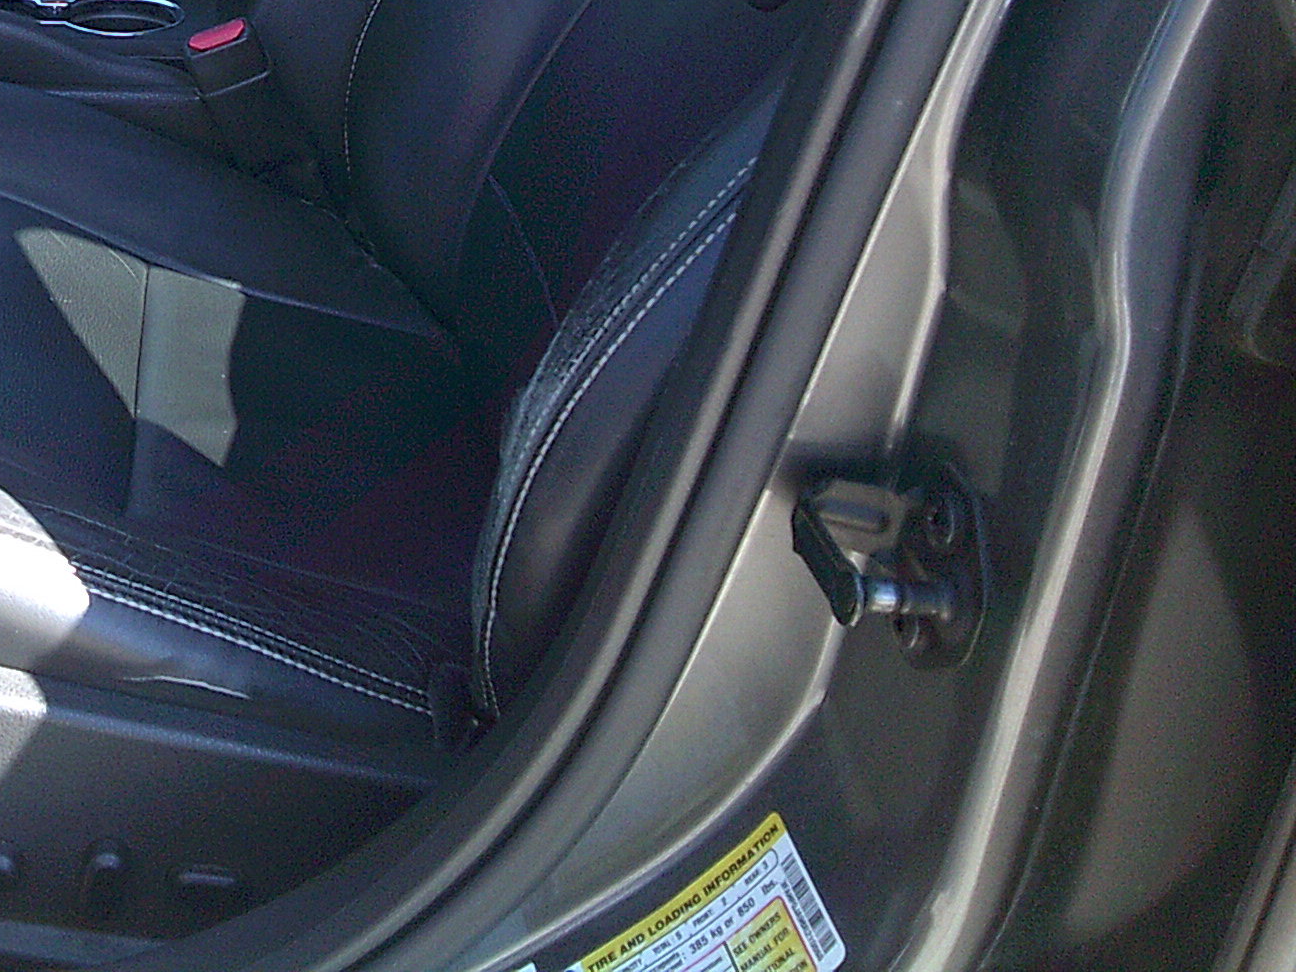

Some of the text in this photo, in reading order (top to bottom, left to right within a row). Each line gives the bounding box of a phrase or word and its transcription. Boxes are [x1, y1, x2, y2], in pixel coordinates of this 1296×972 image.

[587, 950, 617, 972] TIRE
[619, 933, 645, 955] AND
[647, 894, 702, 937] LOADING
[702, 824, 779, 896] INFORMATION
[688, 936, 709, 955] 385
[709, 925, 724, 939] kg
[724, 917, 735, 928] or
[737, 897, 755, 917] 850
[733, 912, 782, 957] SEE OWNERS
[740, 943, 773, 972] MANUAL
[773, 927, 790, 946] FOR
[764, 947, 796, 972] TIONAL
